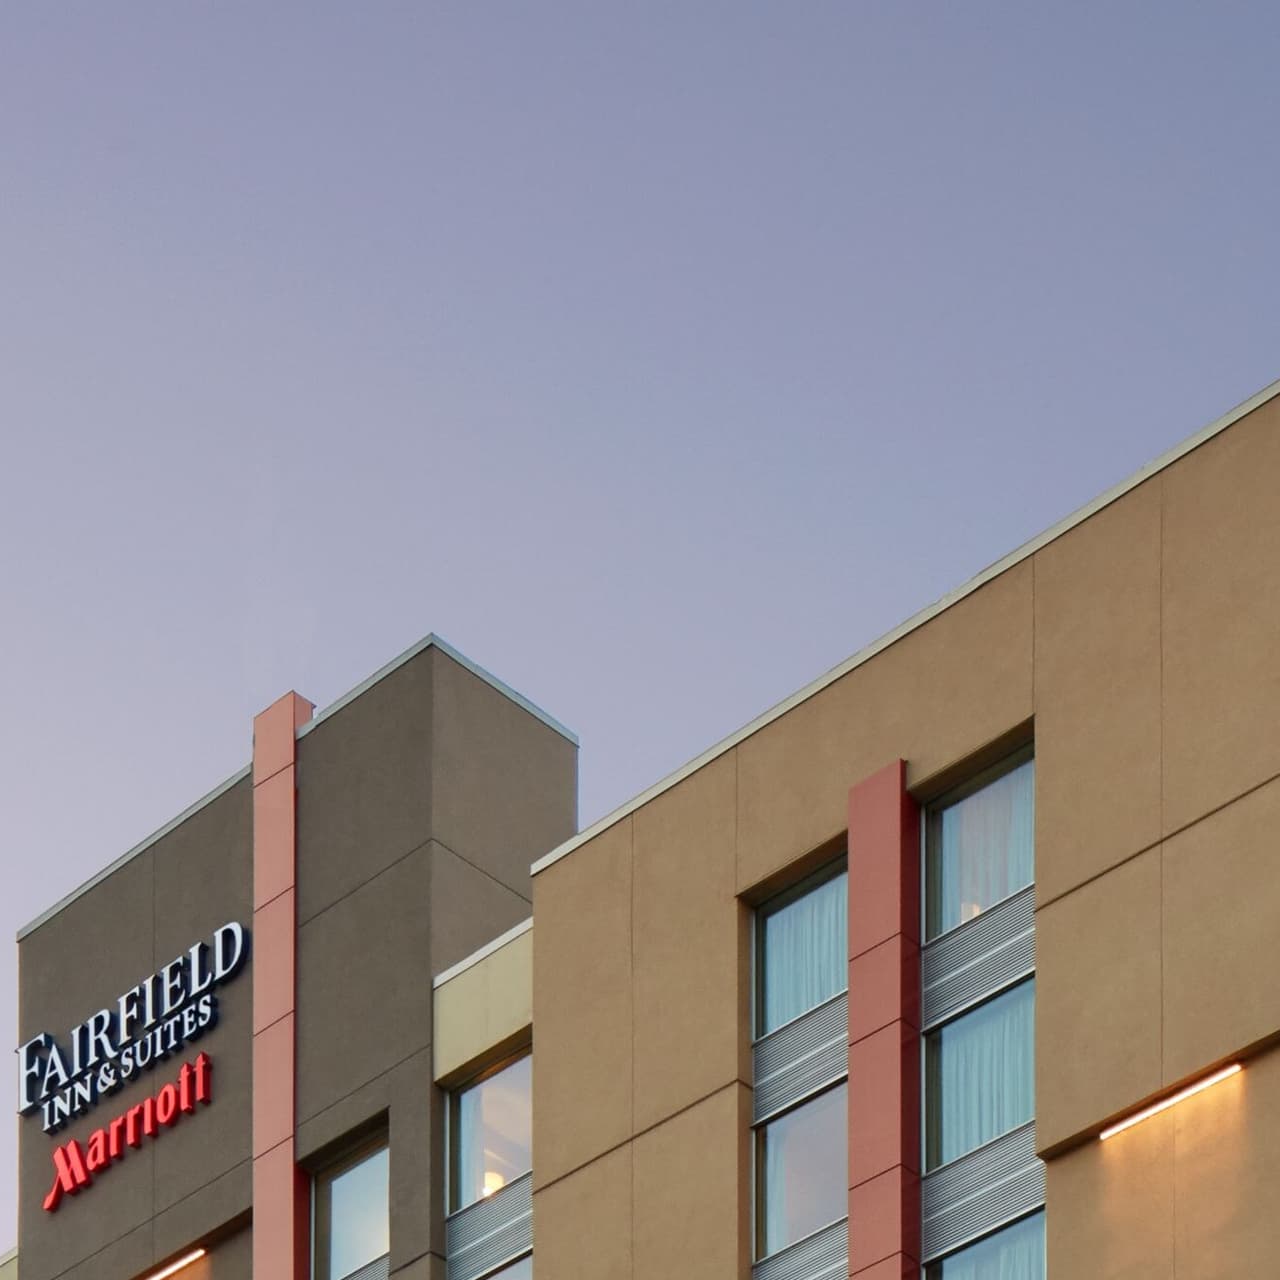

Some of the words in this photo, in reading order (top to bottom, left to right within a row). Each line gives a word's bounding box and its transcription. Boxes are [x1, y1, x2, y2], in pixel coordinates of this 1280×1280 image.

[15, 920, 247, 1114] FAIRFIELD
[41, 1074, 93, 1134] INN
[119, 993, 216, 1079] SUITES
[42, 1050, 213, 1212] Marriott
